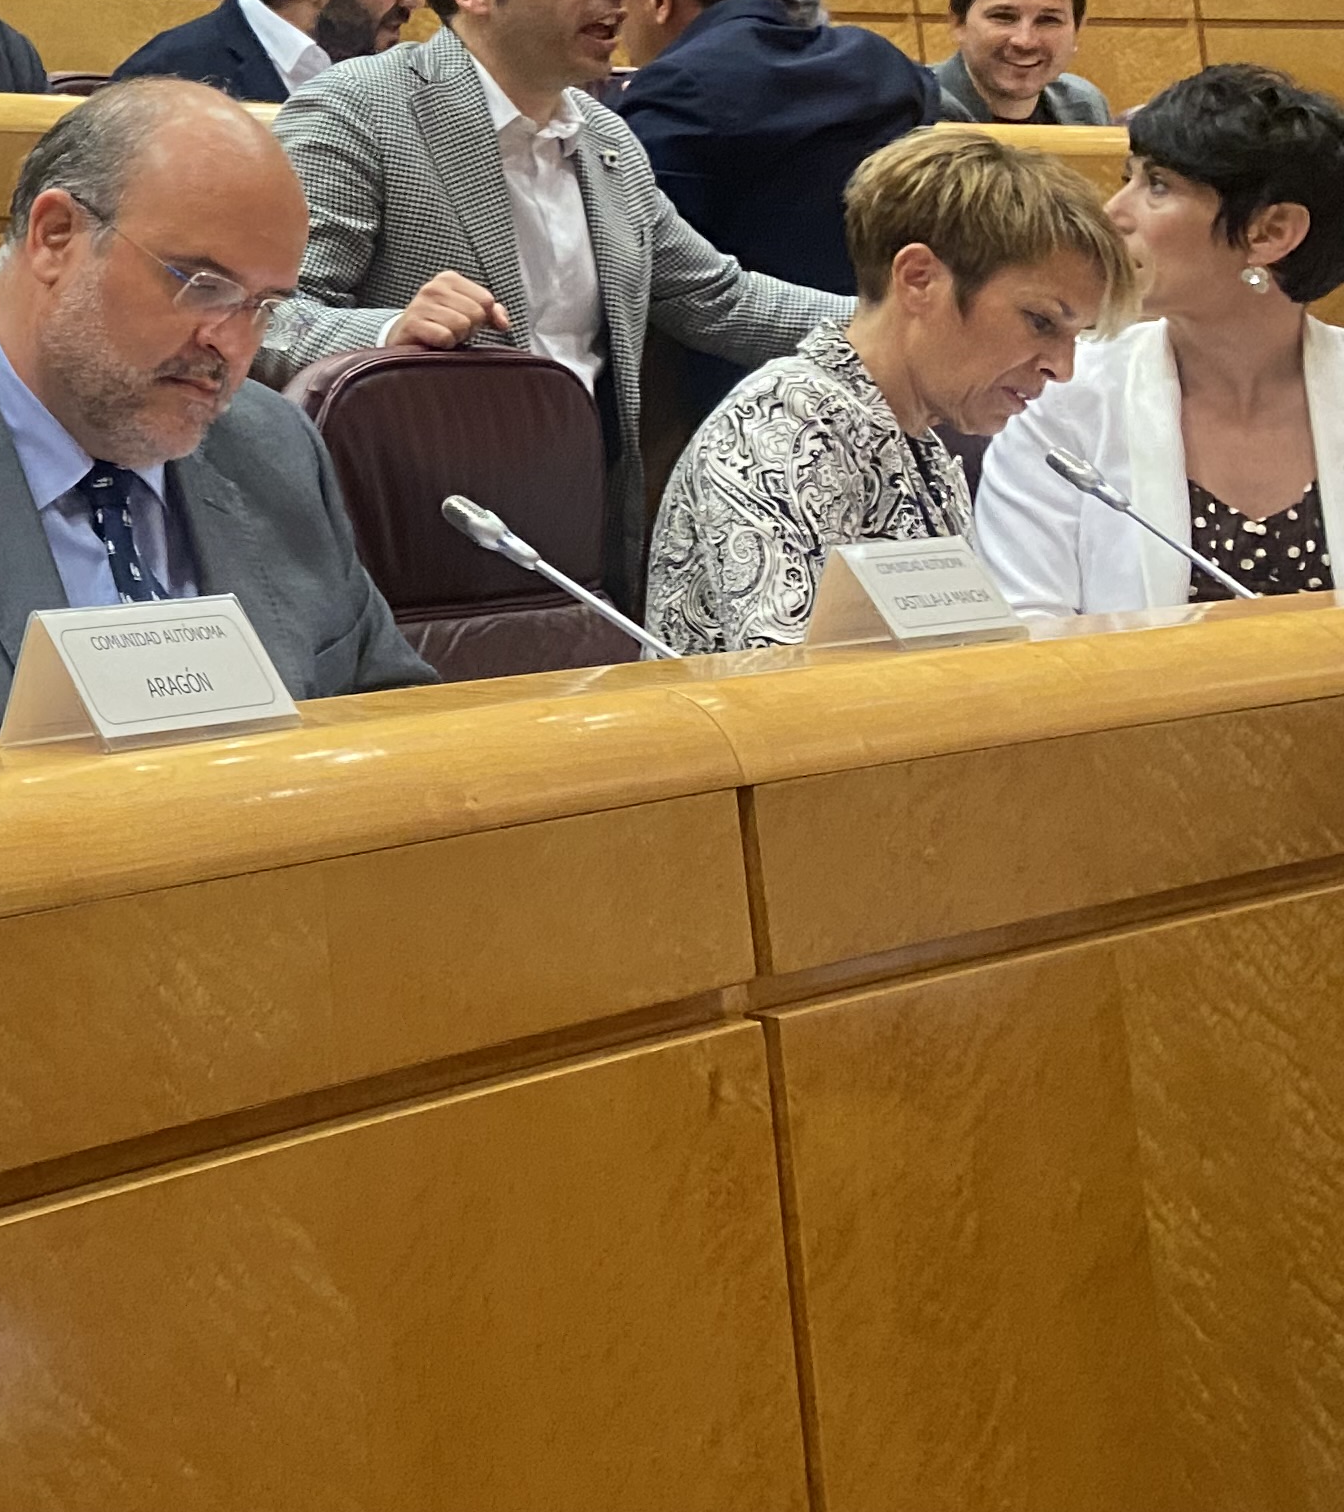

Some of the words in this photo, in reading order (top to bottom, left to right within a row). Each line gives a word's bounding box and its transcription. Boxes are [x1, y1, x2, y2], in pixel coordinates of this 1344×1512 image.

[90, 629, 162, 651] COMUNIDAD
[164, 623, 226, 644] AUTÓNOMA
[146, 667, 215, 698] ARAGÓN
